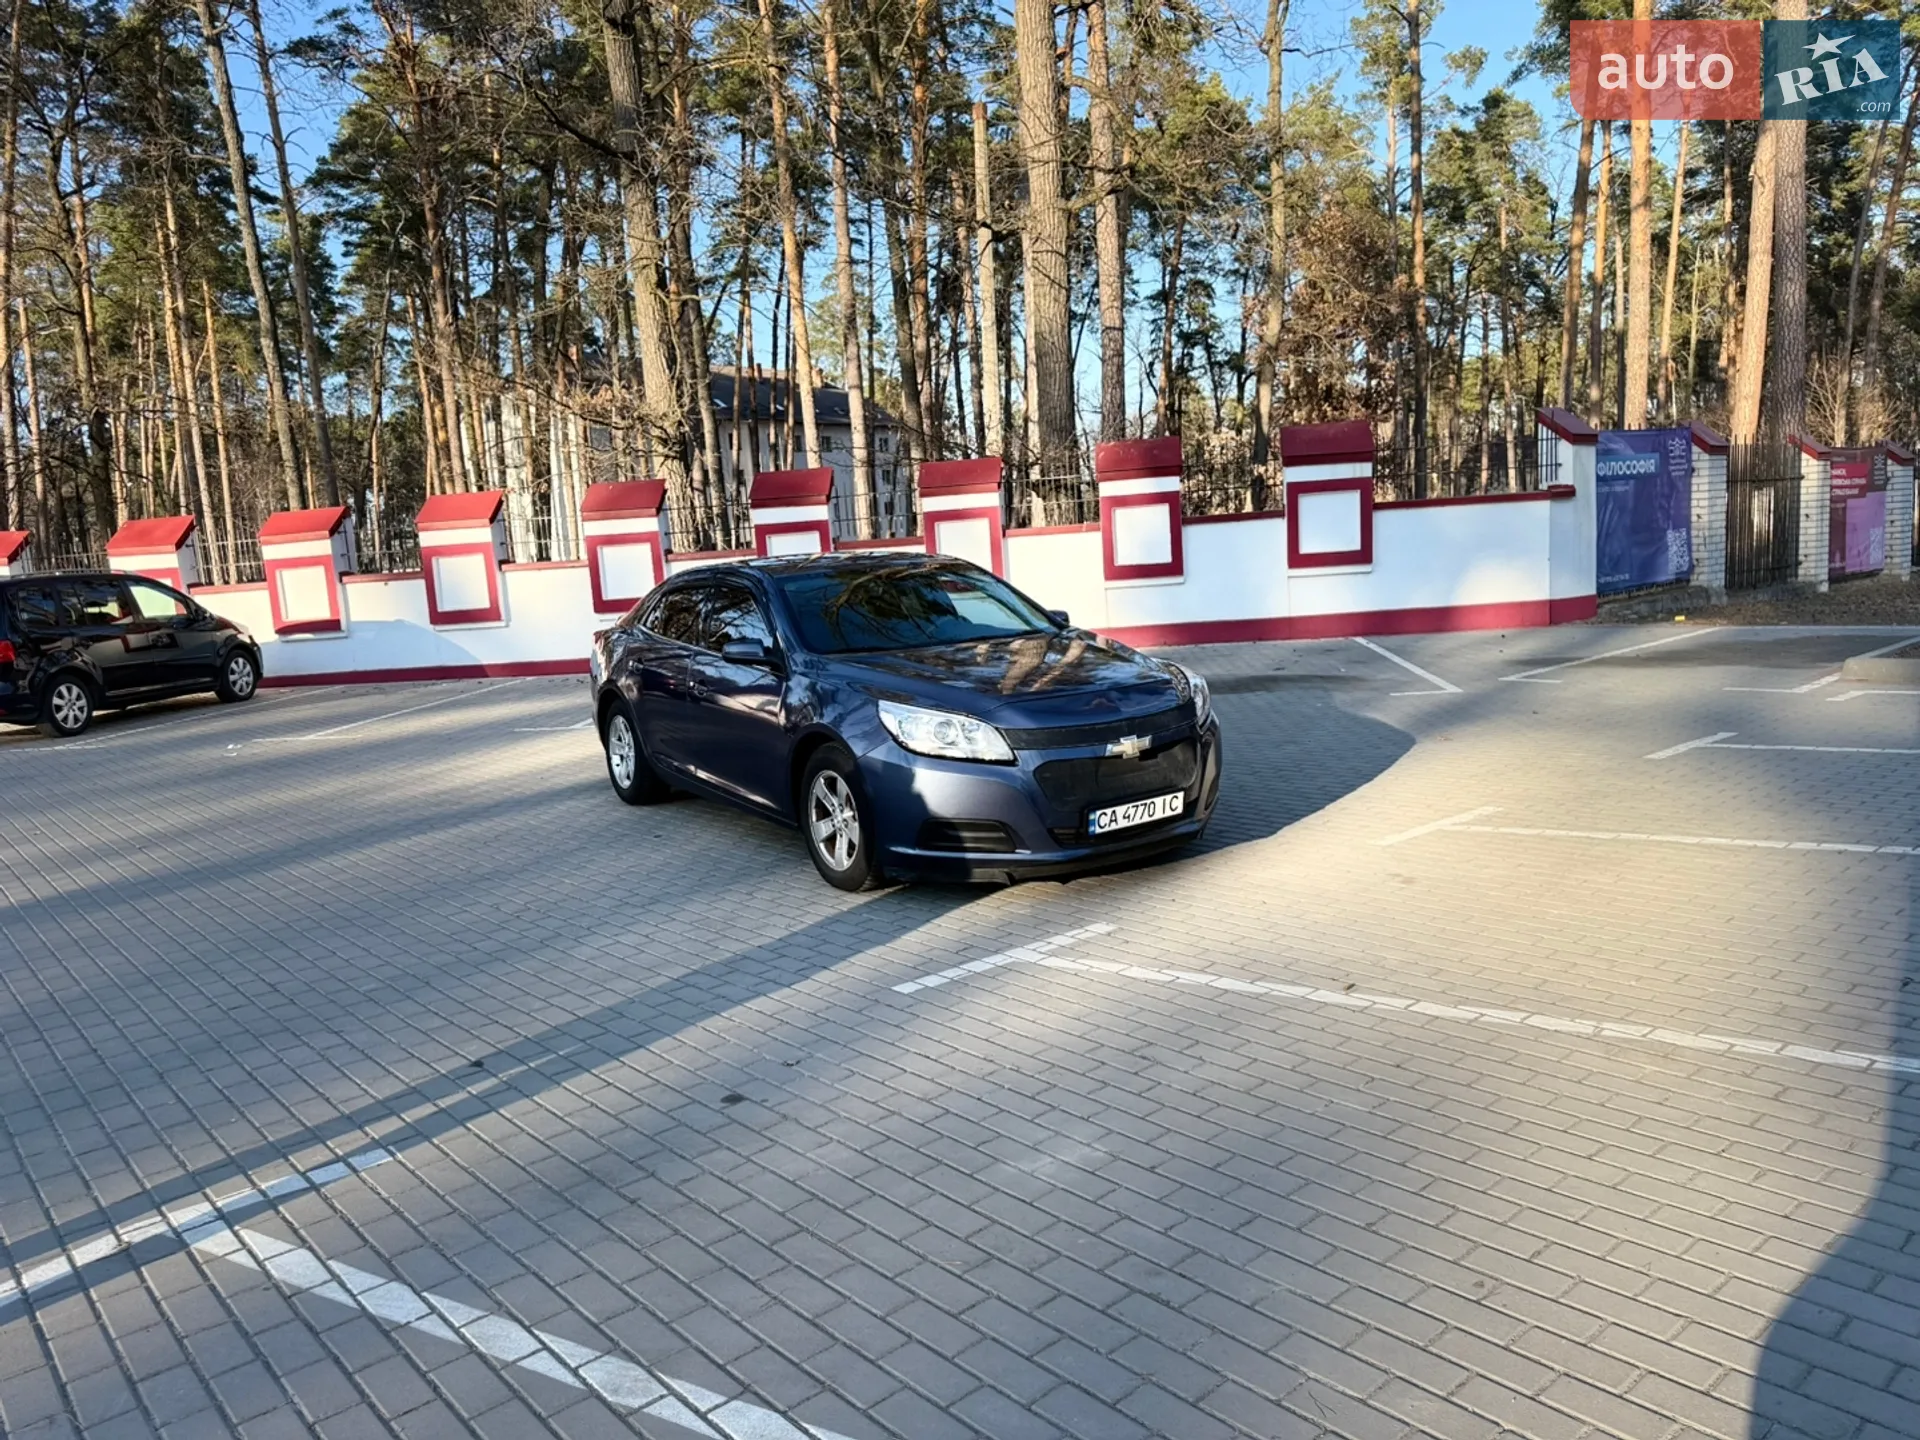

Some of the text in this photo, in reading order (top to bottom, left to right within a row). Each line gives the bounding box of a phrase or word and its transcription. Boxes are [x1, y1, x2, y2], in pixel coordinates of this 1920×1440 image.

[1597, 459, 1656, 477] ФІЛОСОФІЯ
[1097, 810, 1119, 829] CA
[1122, 801, 1156, 823] 4770
